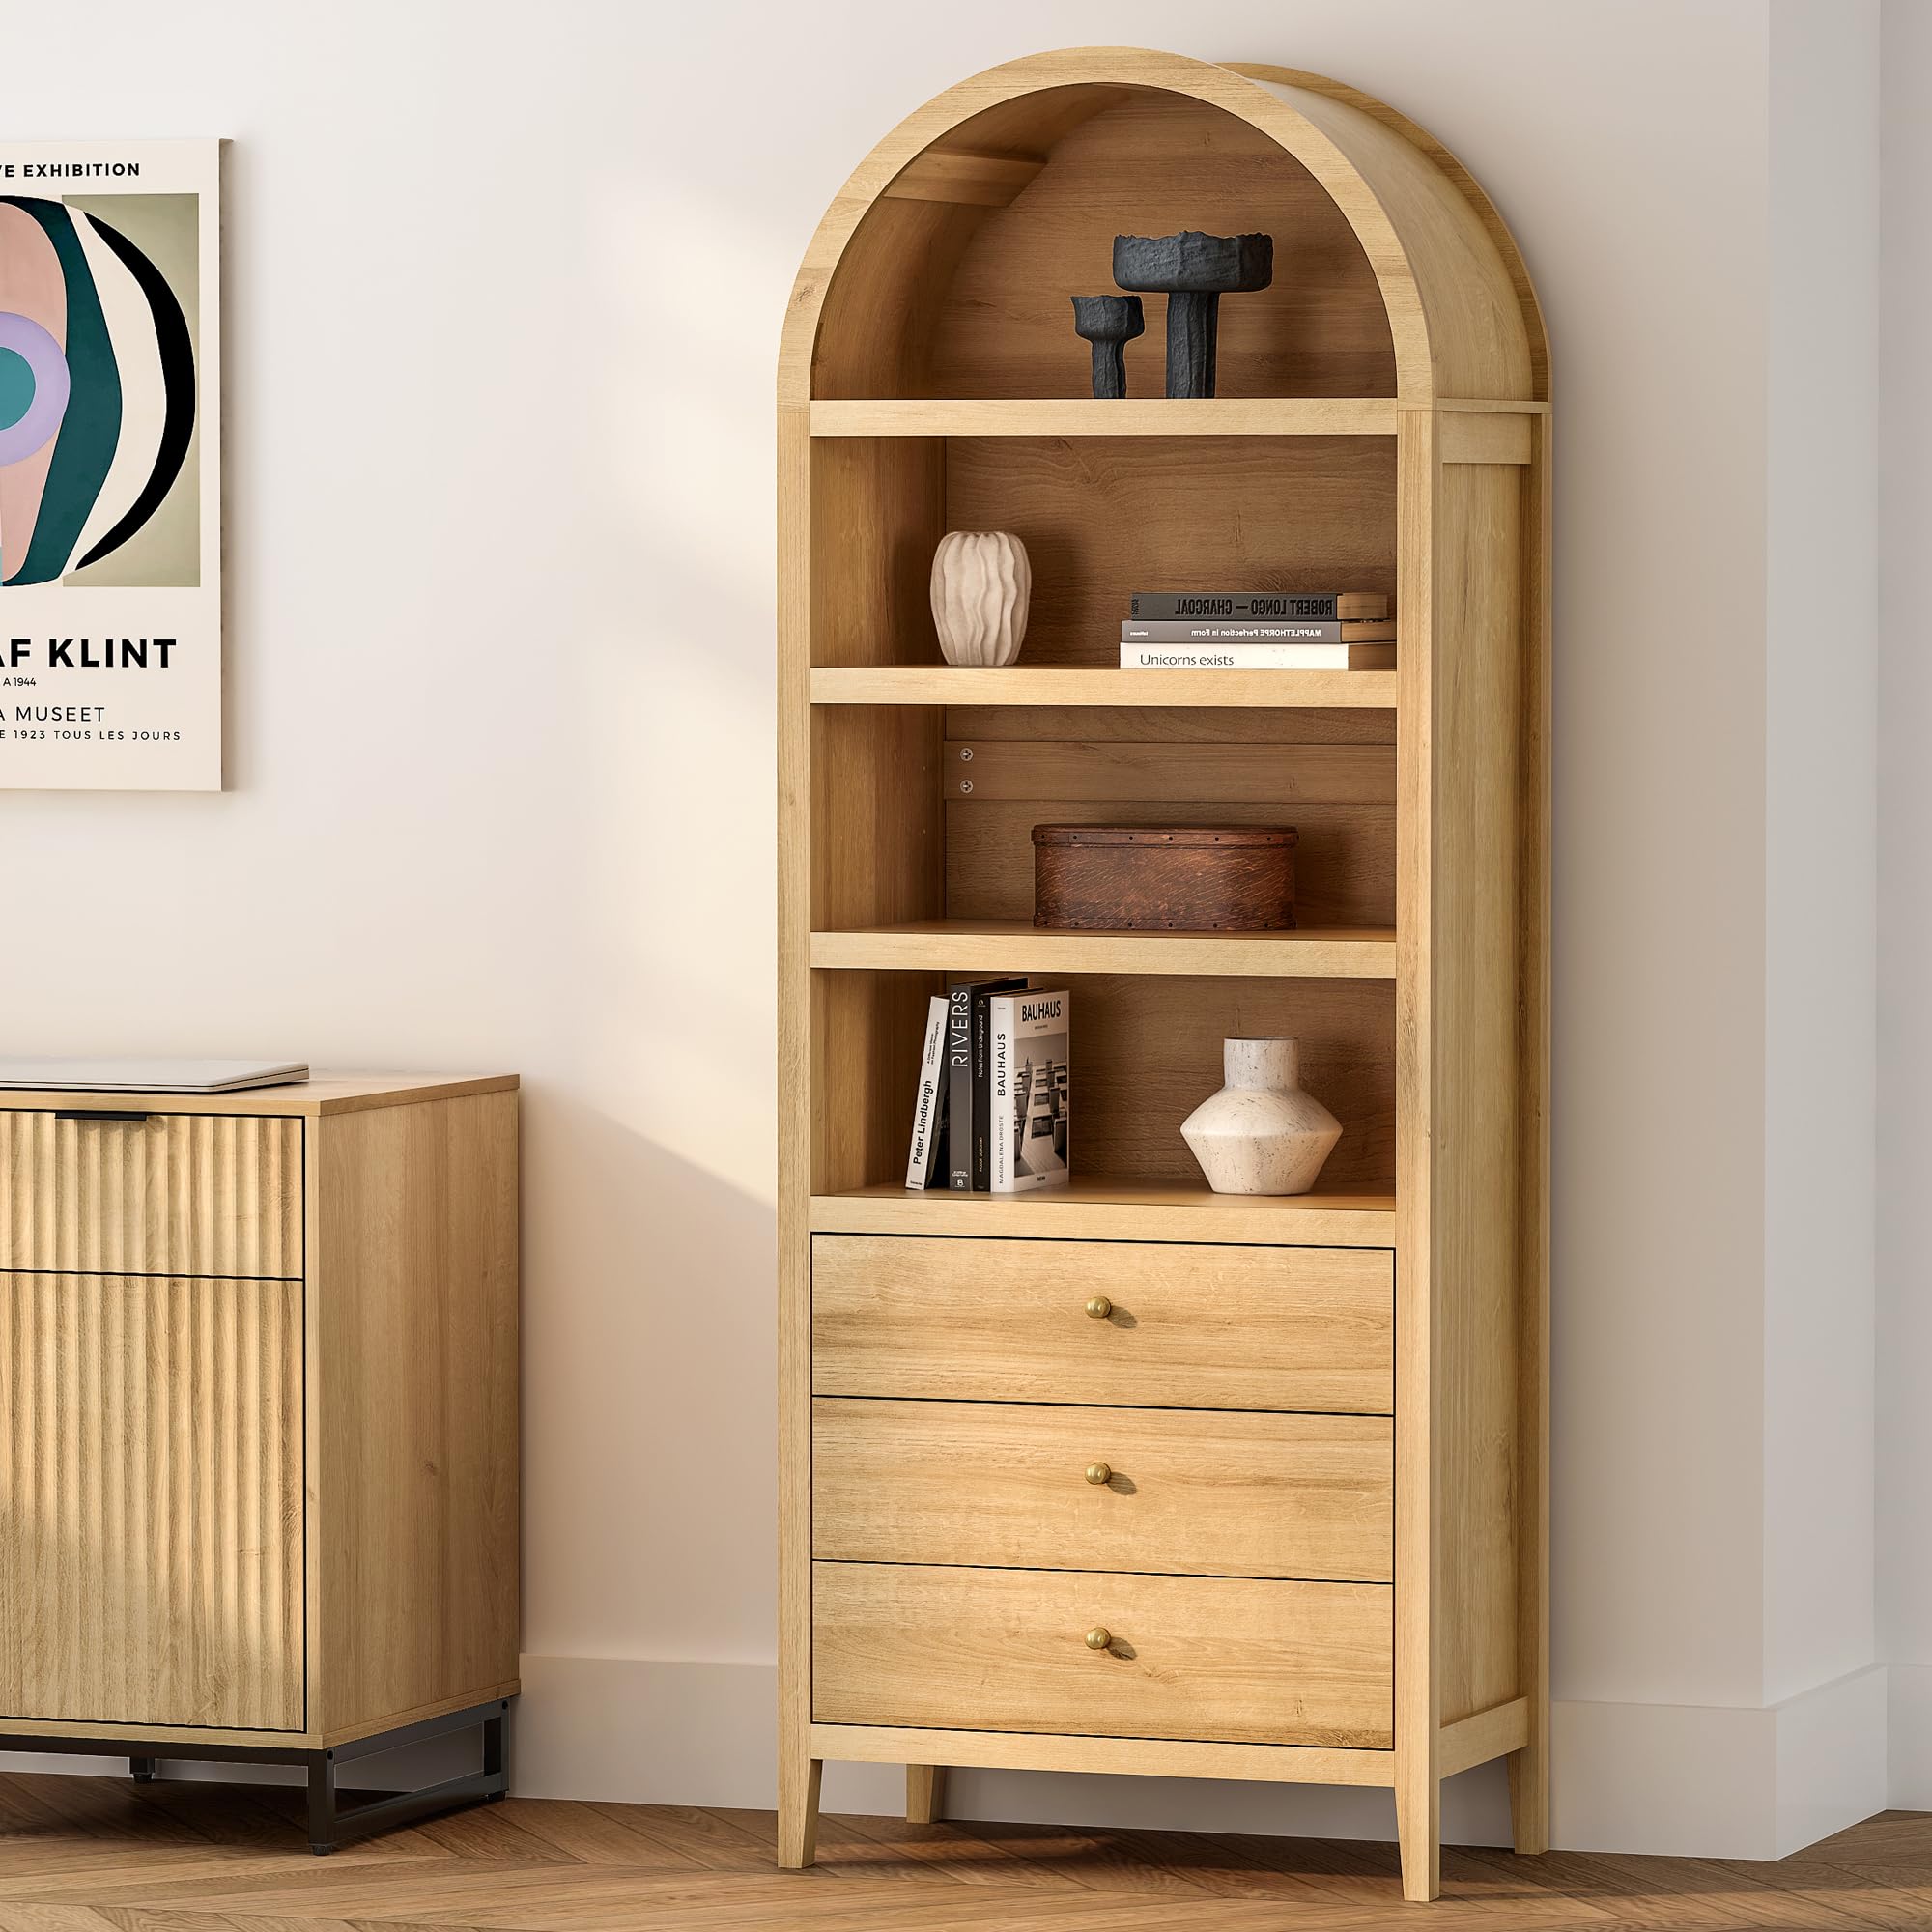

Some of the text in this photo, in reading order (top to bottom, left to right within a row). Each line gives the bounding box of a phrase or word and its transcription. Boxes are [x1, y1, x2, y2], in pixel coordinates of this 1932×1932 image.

[0, 162, 140, 178] E EXHIBITION
[0, 638, 177, 668] F KLINT
[1140, 653, 1235, 666] Unicorns exists
[3, 677, 37, 687] A 1944
[15, 706, 105, 723] MUSEET
[14, 730, 46, 740] 1923
[54, 730, 92, 740] TOUS
[99, 730, 125, 740] LES
[132, 731, 182, 741] JOURS
[1022, 1001, 1061, 1022] BAUHAUS
[952, 991, 968, 1067] RIVERS
[997, 1033, 1006, 1096] BAUHAUS
[918, 1080, 933, 1135] Lindbergh
[913, 1136, 924, 1165] Peter
